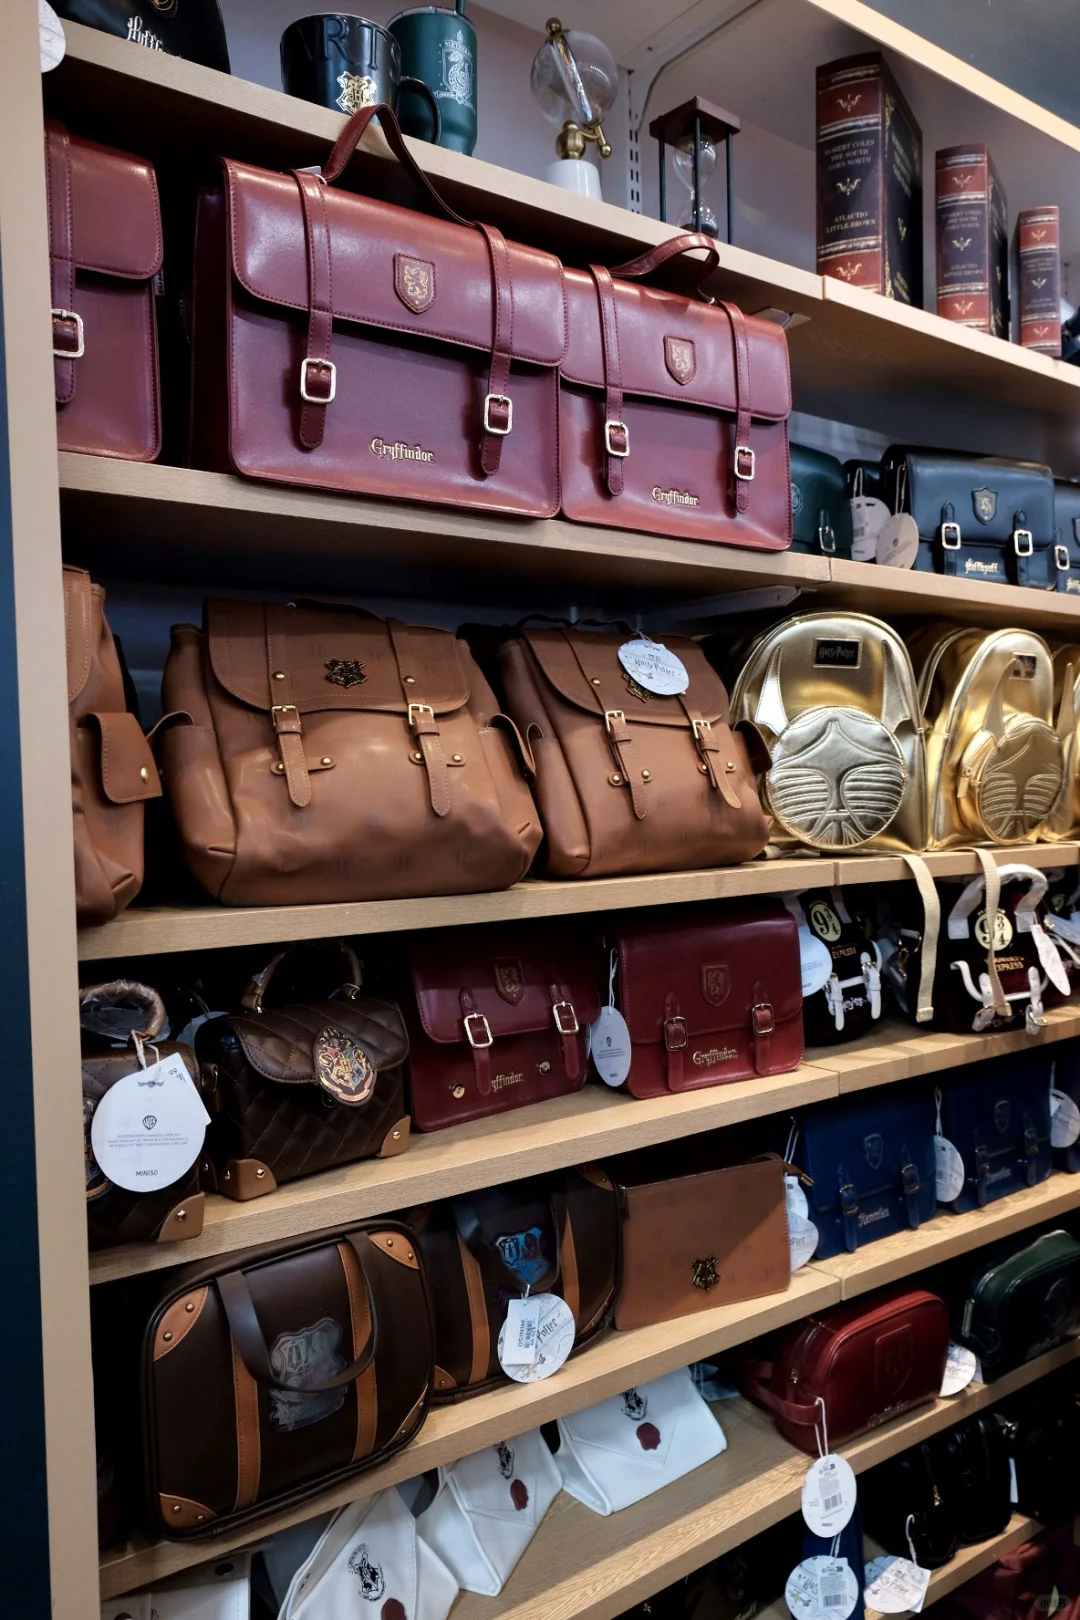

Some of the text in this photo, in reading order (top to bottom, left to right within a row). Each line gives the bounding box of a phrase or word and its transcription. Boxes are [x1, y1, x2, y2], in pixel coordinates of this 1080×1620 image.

[852, 140, 875, 149] COLES
[830, 149, 868, 162] THE SOUTH
[847, 157, 871, 166] NORTH
[826, 219, 876, 233] LITTLE BROWN
[371, 438, 434, 462] Gryffindor
[652, 486, 699, 506] Gryffindor
[692, 1047, 738, 1066] Gryffindor
[517, 1319, 526, 1347] MINISO
